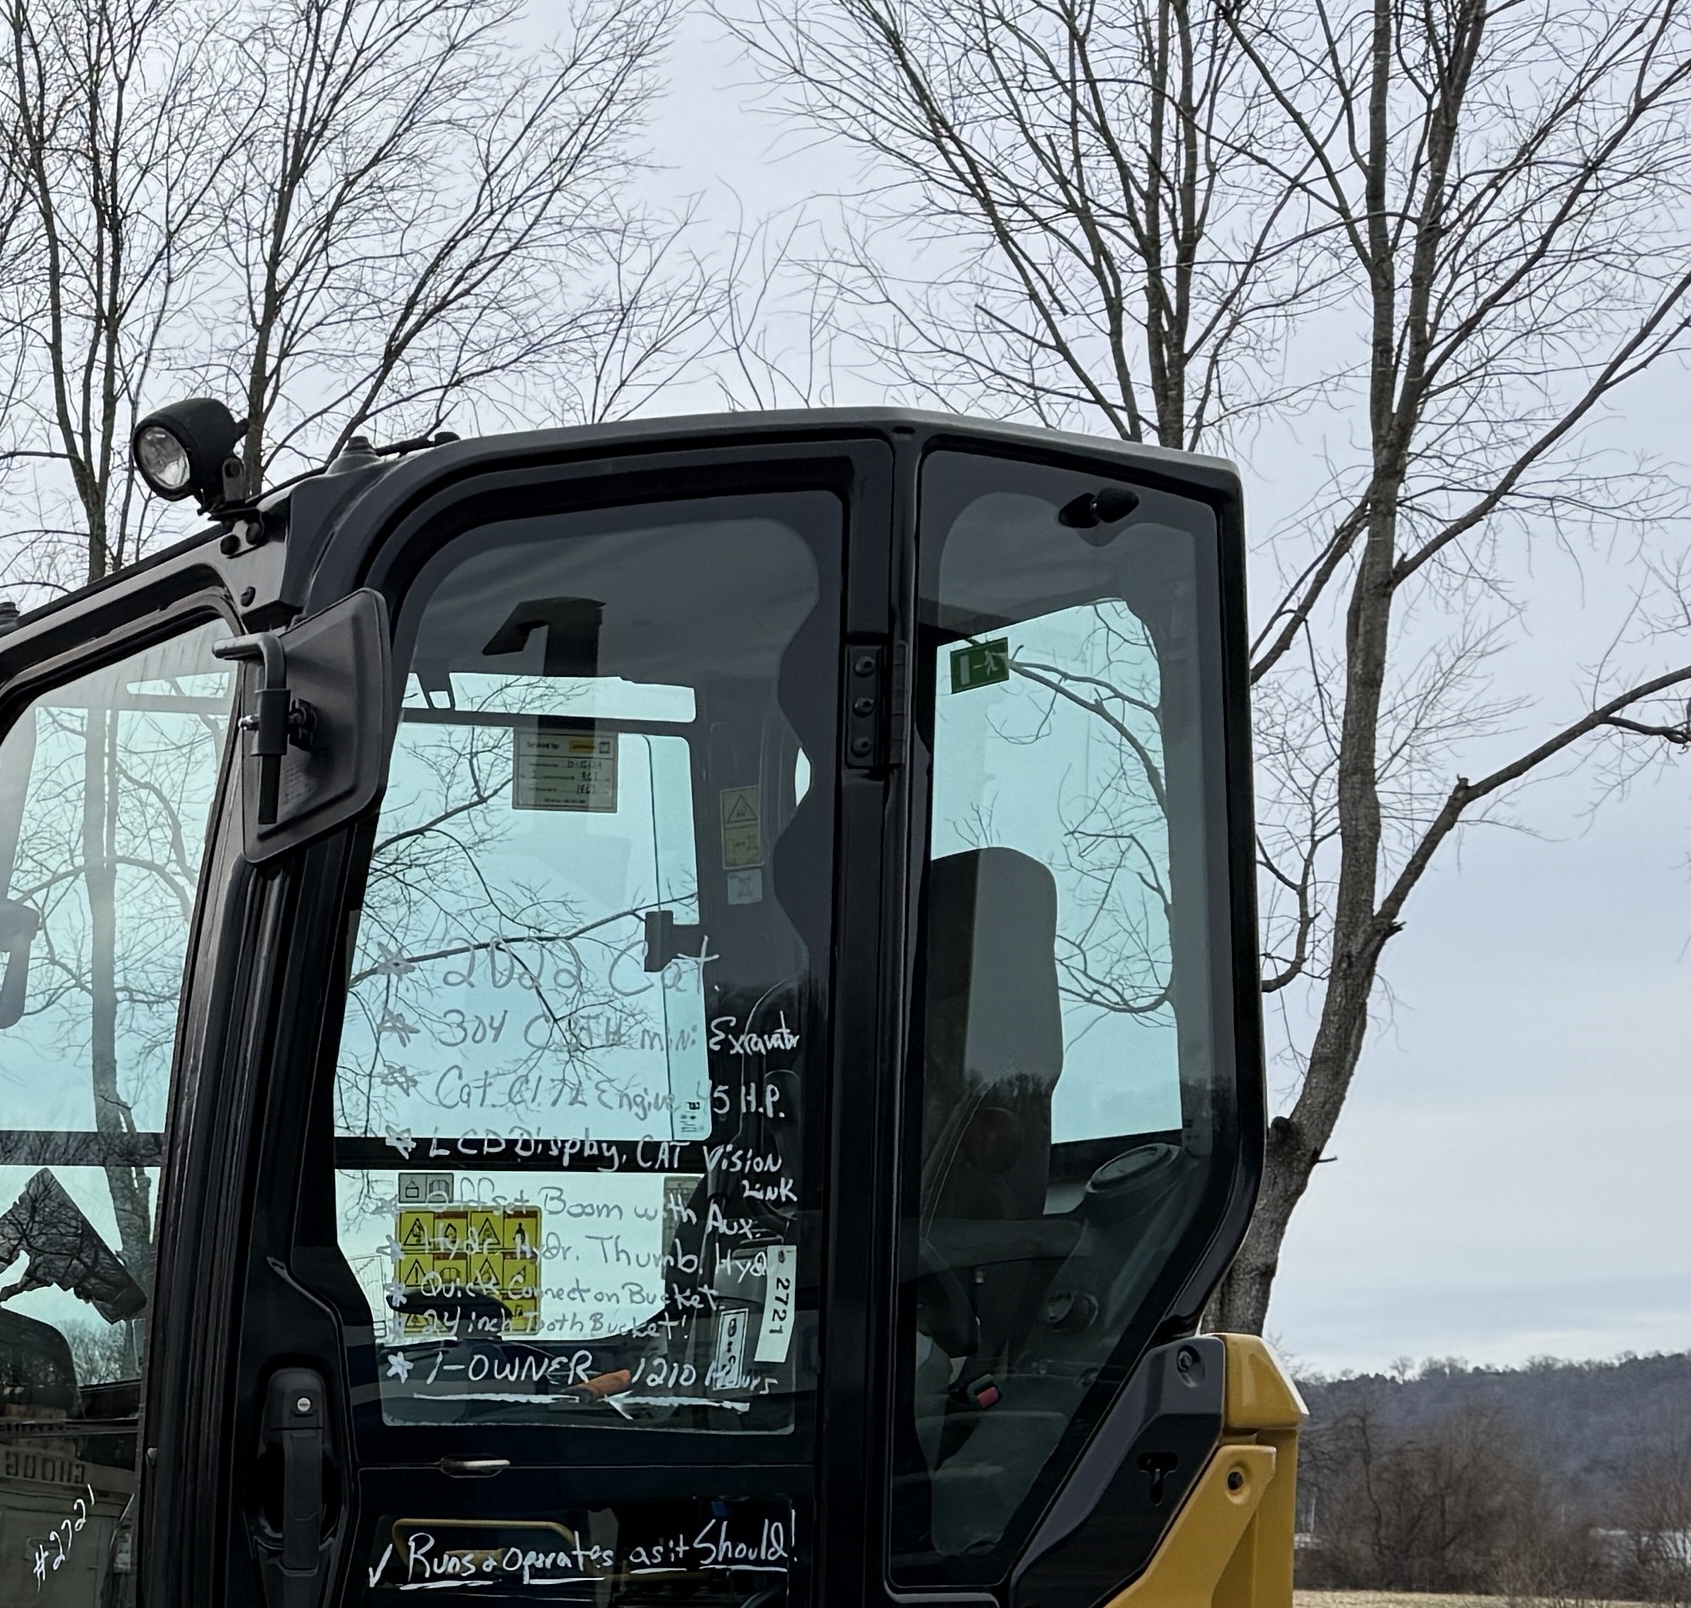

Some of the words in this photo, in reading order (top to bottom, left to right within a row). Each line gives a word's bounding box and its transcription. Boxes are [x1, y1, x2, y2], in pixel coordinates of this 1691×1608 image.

[438, 1008, 509, 1048] 304
[740, 1081, 786, 1118] H.P.
[429, 1125, 506, 1158] LCD
[538, 1186, 624, 1221] Boom
[420, 1270, 500, 1299] Quick
[594, 1288, 620, 1305] on
[769, 1276, 791, 1334] 2721
[467, 1306, 513, 1333] inch
[631, 1357, 697, 1387] 1210
[406, 1531, 477, 1578] Runs
